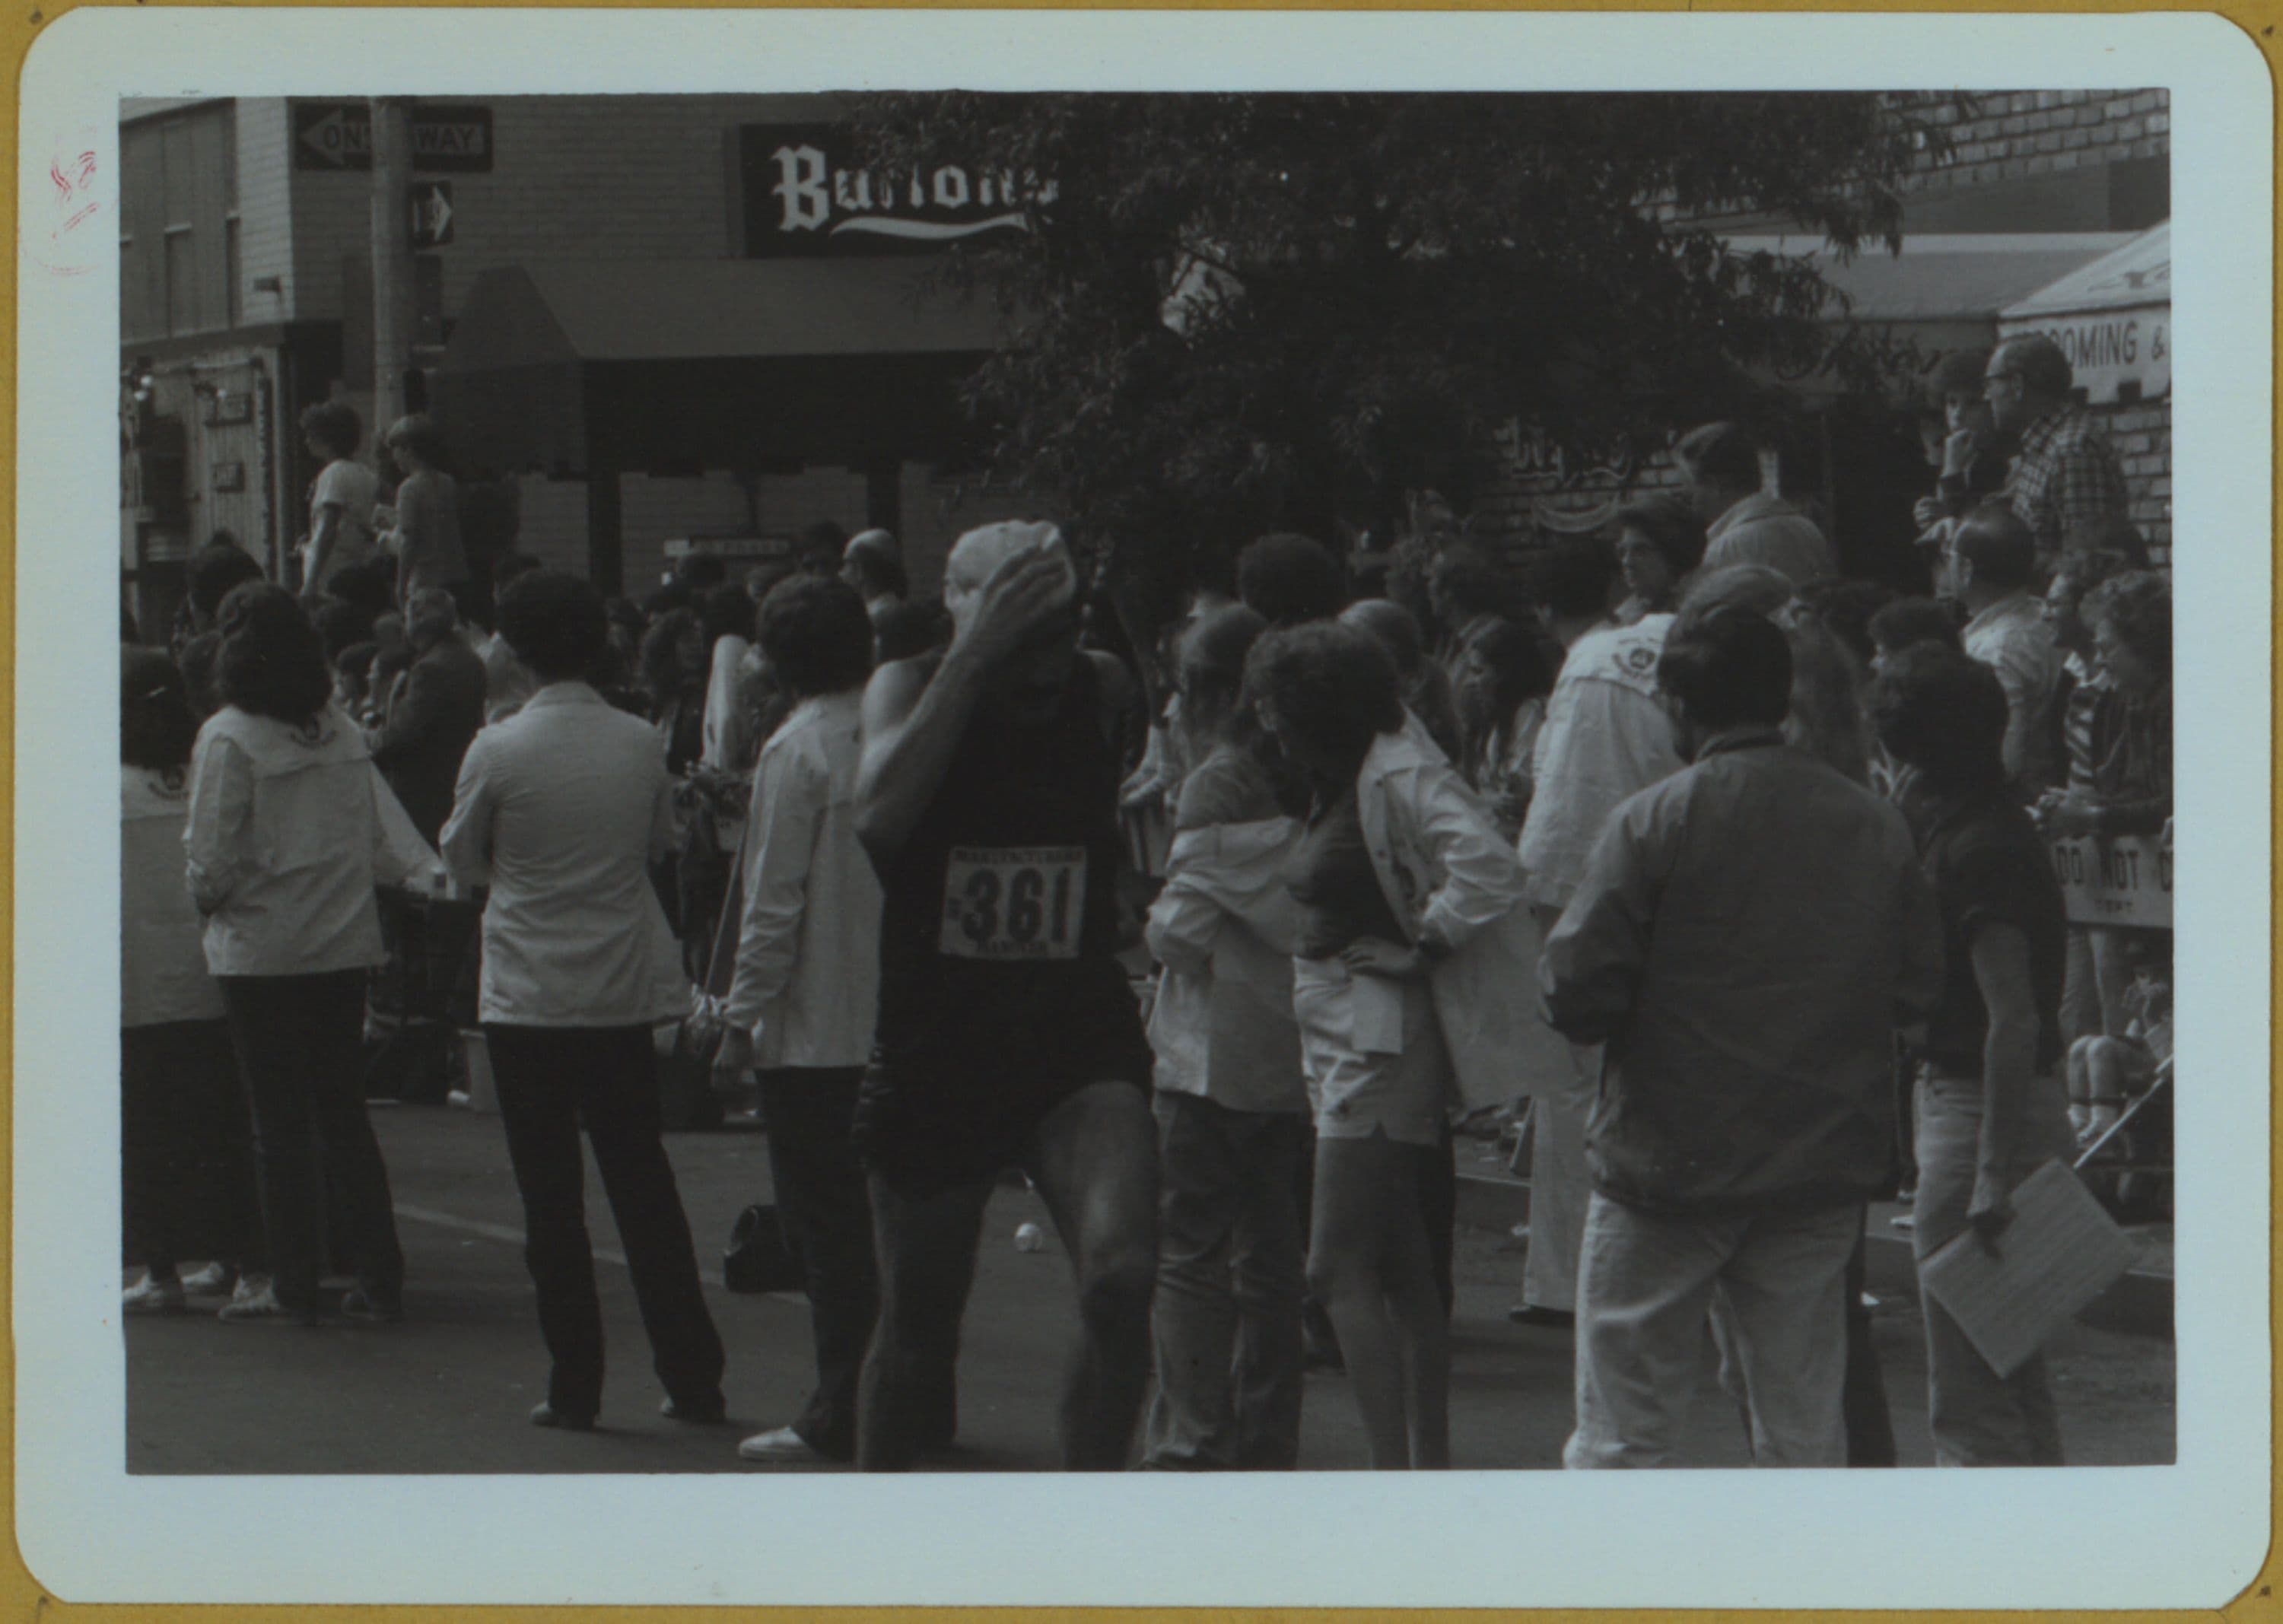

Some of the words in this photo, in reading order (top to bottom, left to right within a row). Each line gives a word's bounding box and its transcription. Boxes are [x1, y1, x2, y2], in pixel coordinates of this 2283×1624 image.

[418, 126, 474, 151] WAY
[2057, 847, 2083, 885] DO
[2102, 851, 2138, 890] NOT
[963, 869, 1070, 942] 361
